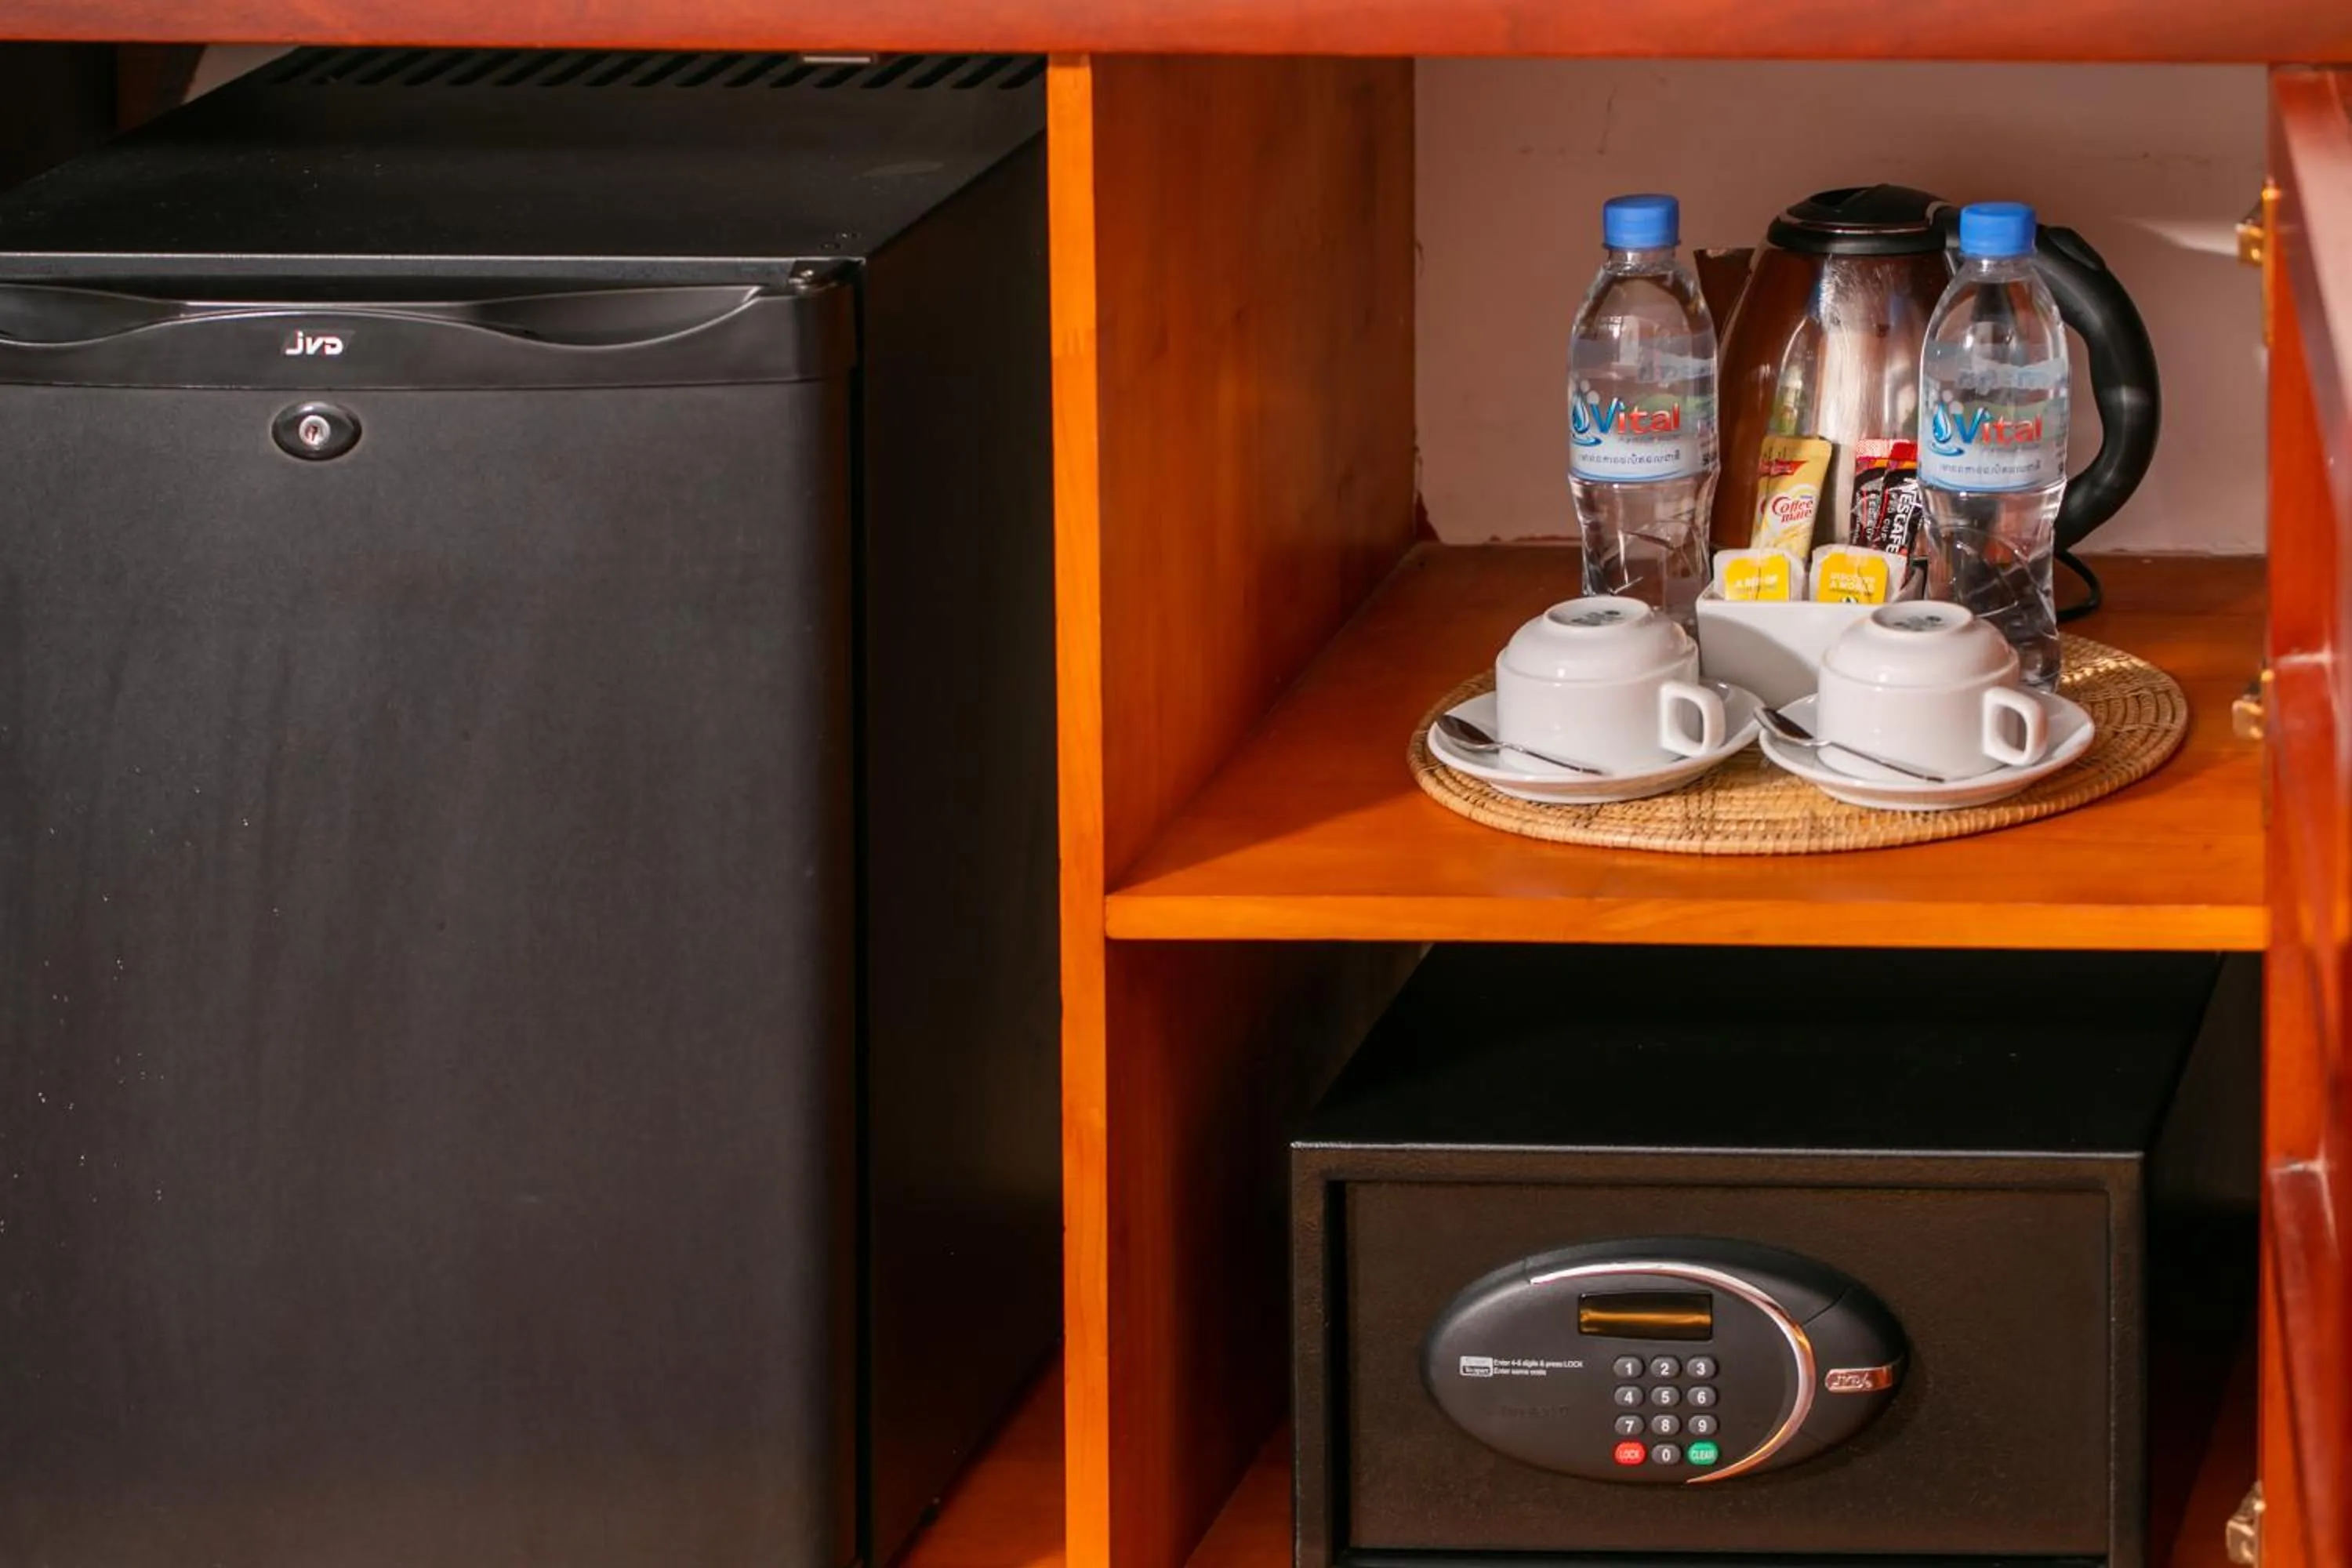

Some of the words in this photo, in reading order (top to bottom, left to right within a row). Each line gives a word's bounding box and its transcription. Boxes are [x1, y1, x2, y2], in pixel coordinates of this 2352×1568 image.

[1589, 397, 1680, 434] Vital
[1953, 407, 2043, 445] Vital
[1773, 496, 1813, 516] Coffee
[1781, 510, 1812, 523] mate
[1625, 1363, 1632, 1376] 1
[1661, 1363, 1669, 1376] 2
[1697, 1363, 1706, 1376] 3
[1624, 1391, 1633, 1404] 4
[1661, 1390, 1670, 1404] 5
[1697, 1391, 1706, 1404] 6
[1625, 1420, 1634, 1433] 7
[1661, 1419, 1670, 1433] 8
[1697, 1419, 1707, 1433] 9
[1621, 1449, 1639, 1459] LOCK
[1662, 1448, 1671, 1462] 0
